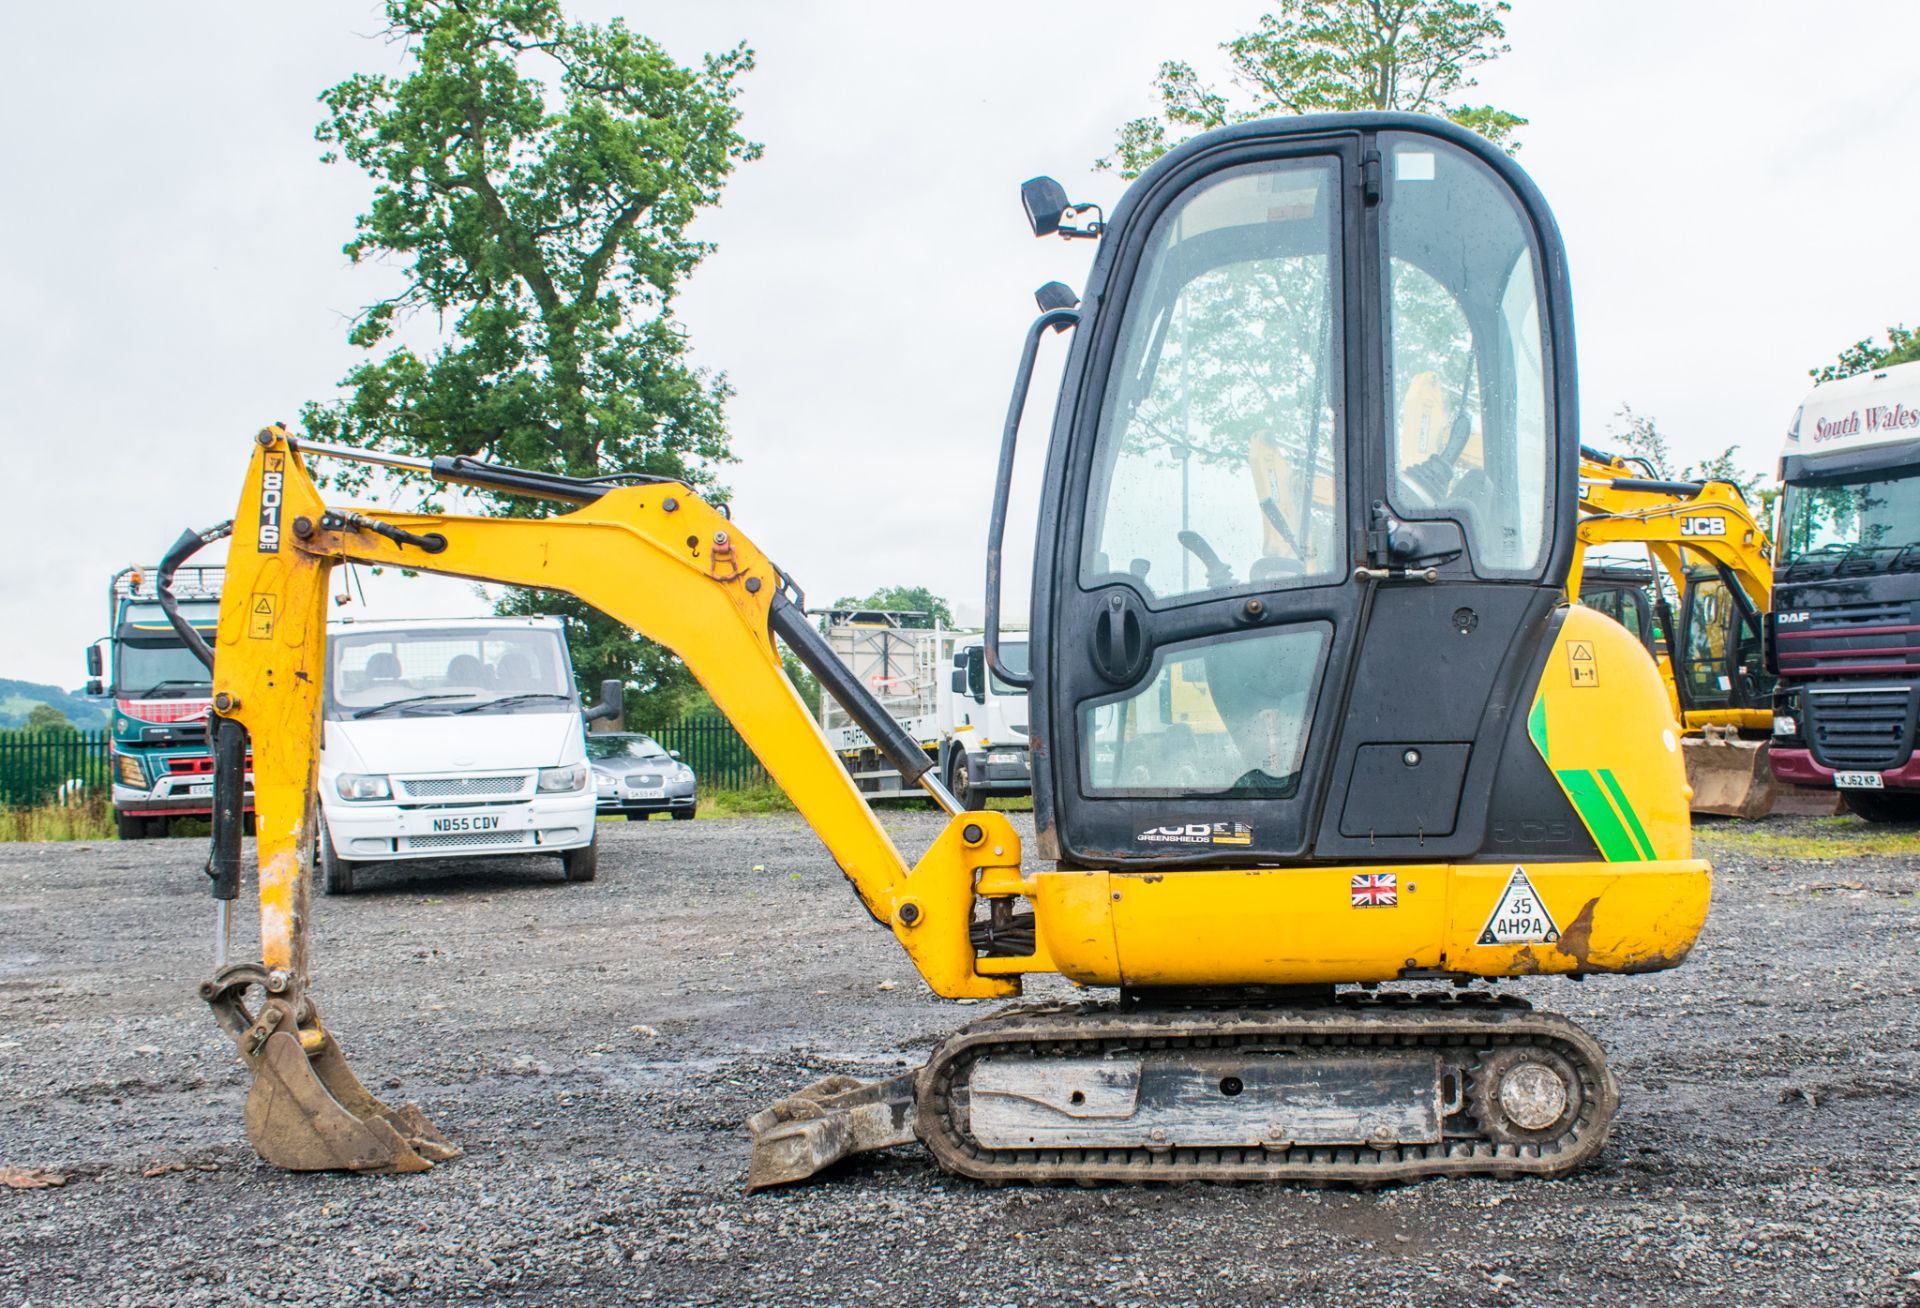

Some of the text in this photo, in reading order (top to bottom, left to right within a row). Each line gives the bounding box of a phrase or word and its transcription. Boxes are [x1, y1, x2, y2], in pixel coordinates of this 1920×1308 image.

[1813, 403, 1920, 442] South Wales
[259, 472, 283, 544] 8016
[1681, 517, 1725, 535] JCB
[1778, 612, 1810, 624] DAF
[433, 816, 500, 832] ND55 CDV
[1137, 834, 1210, 843] GREENSHIELDS
[1510, 897, 1532, 915] 35
[1497, 918, 1543, 935] AH9A
